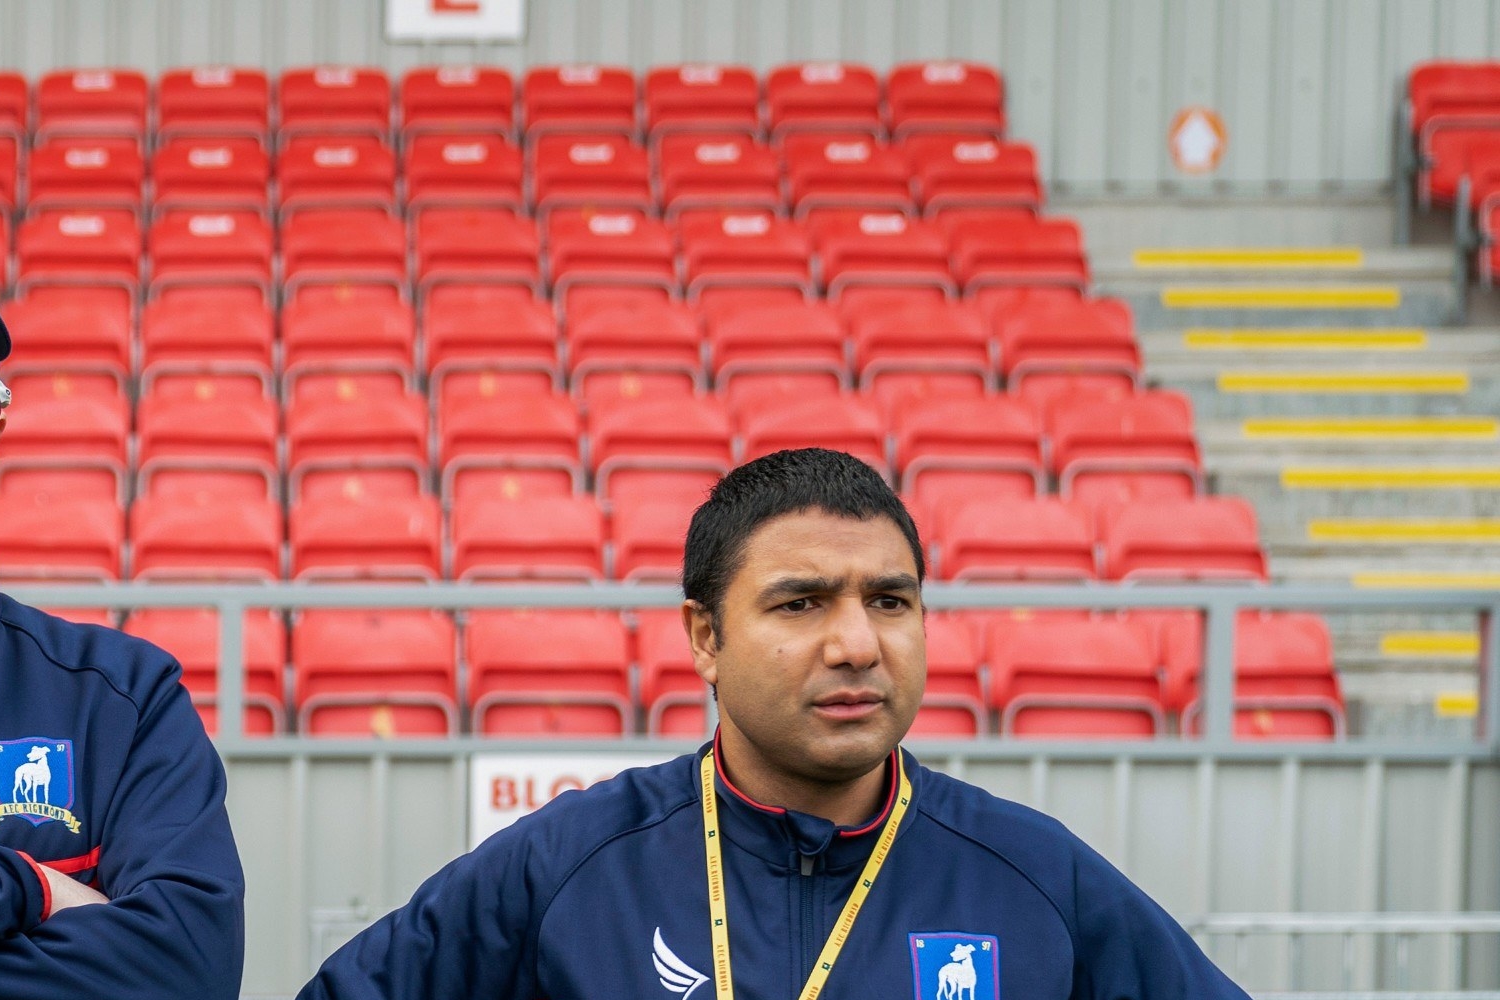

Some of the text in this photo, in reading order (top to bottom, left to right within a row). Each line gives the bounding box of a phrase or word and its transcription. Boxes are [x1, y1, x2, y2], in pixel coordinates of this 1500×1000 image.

[491, 775, 615, 809] BLO
[705, 783, 713, 814] RICHMOND
[23, 804, 65, 820] RICHMOND
[881, 820, 898, 851] RICHMOND
[710, 869, 720, 901] RICHMOND
[841, 902, 859, 933] RICHMOND
[718, 959, 728, 992] RICHMOND
